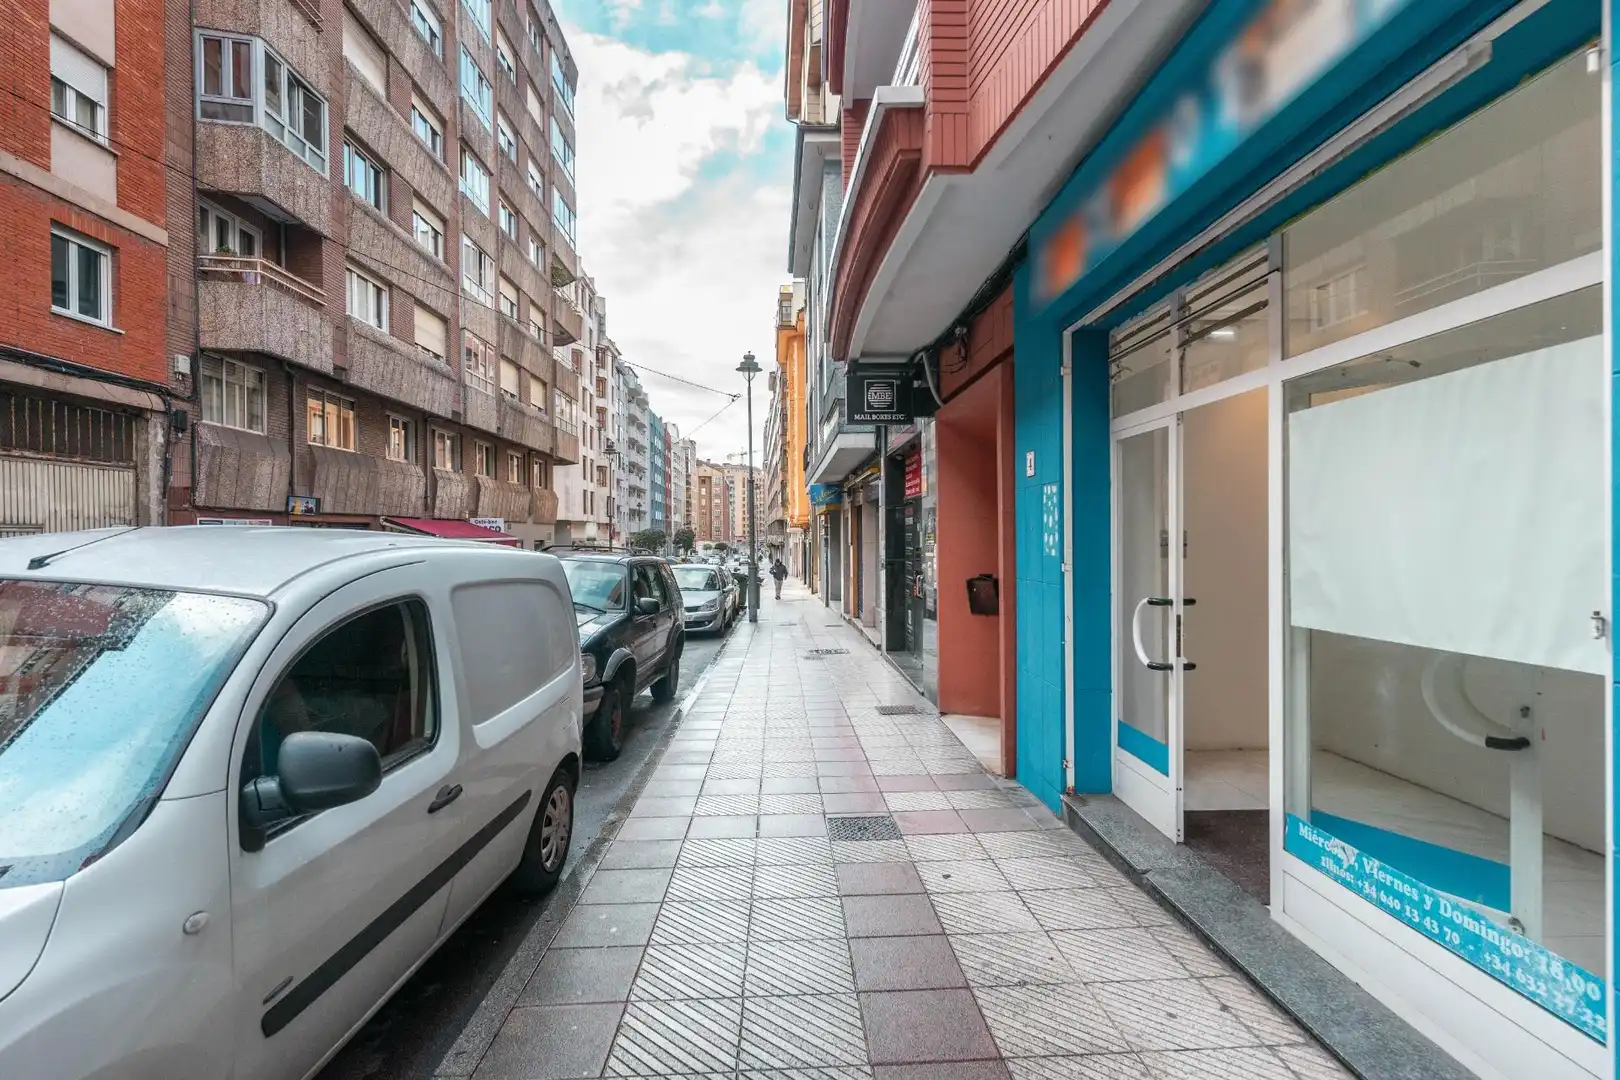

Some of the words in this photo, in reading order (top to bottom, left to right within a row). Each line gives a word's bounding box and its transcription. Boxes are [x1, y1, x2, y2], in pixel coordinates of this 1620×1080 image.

[871, 392, 892, 400] MBE
[1362, 857, 1419, 901] Viernes
[1423, 893, 1434, 911] y
[1380, 889, 1401, 911] 640
[1405, 903, 1420, 923] 13
[1423, 916, 1440, 935] 43
[1443, 925, 1461, 945] 70
[1484, 951, 1511, 977] +34
[1516, 967, 1548, 998] 632
